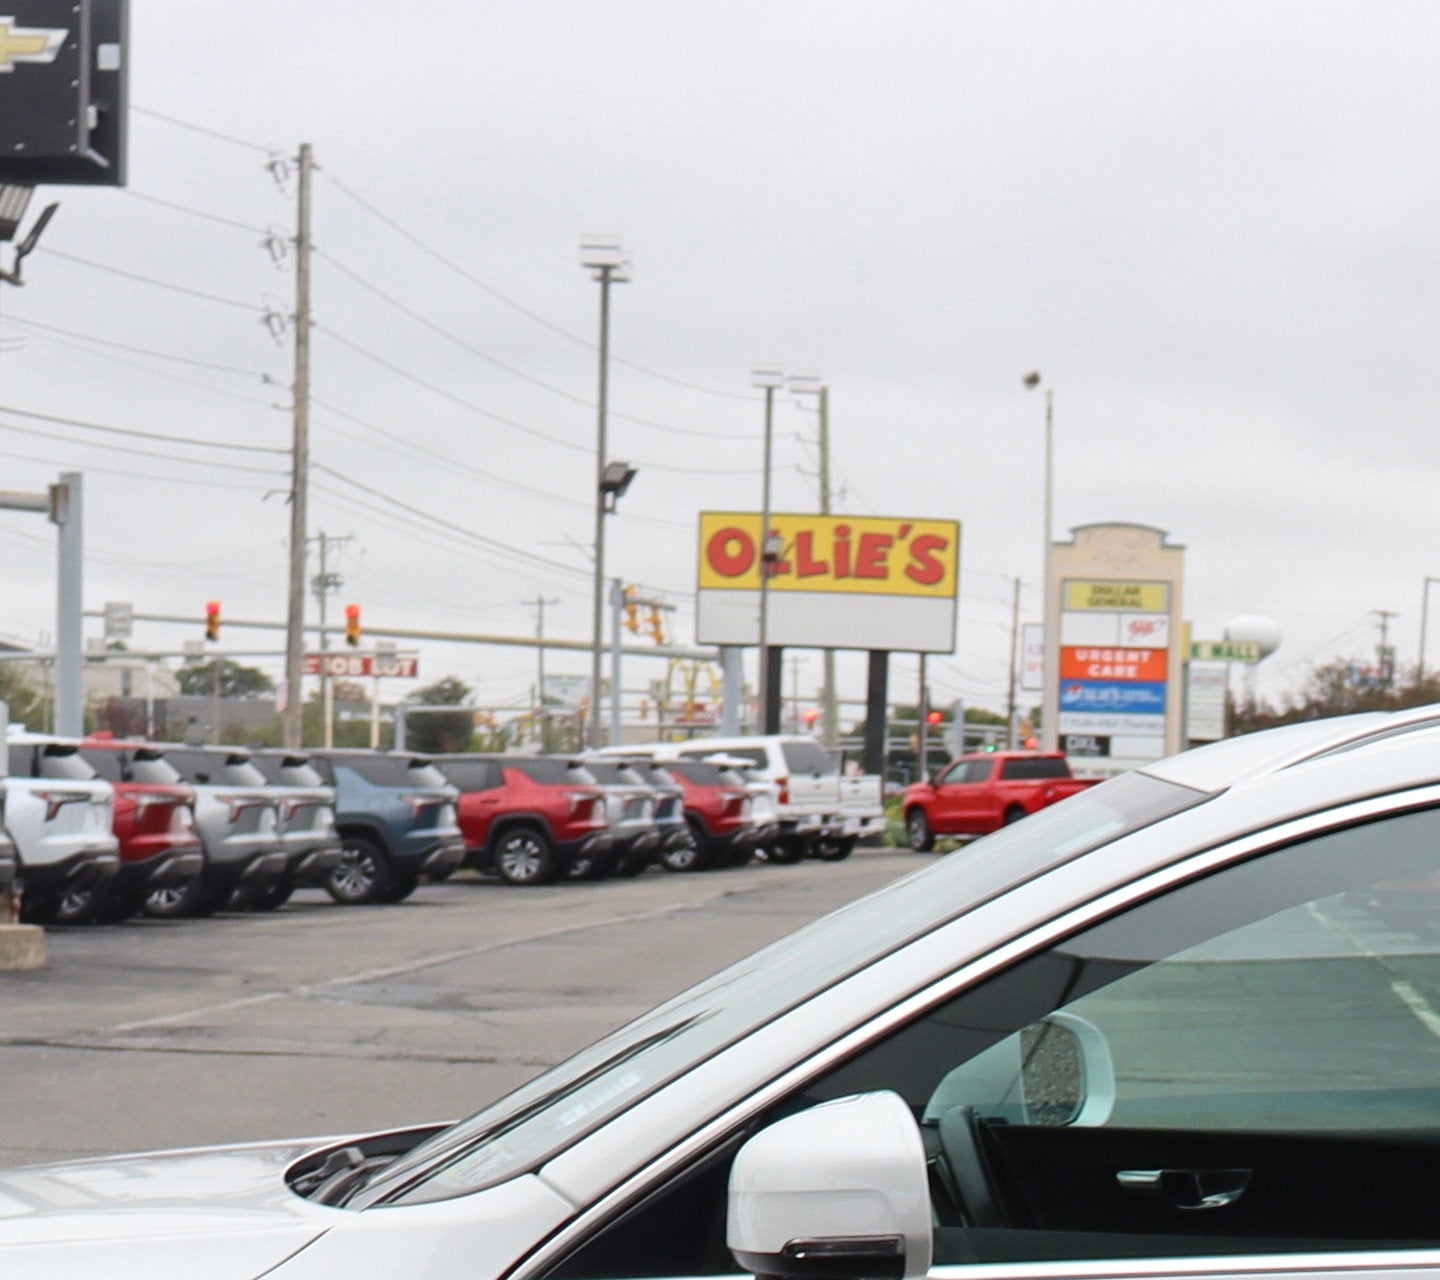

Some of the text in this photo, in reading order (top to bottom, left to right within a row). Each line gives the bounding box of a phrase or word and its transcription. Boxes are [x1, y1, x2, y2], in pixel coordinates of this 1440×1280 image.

[1090, 583, 1141, 595] DOLLAR
[1075, 650, 1152, 662] URGENT
[1087, 664, 1138, 677] CARE
